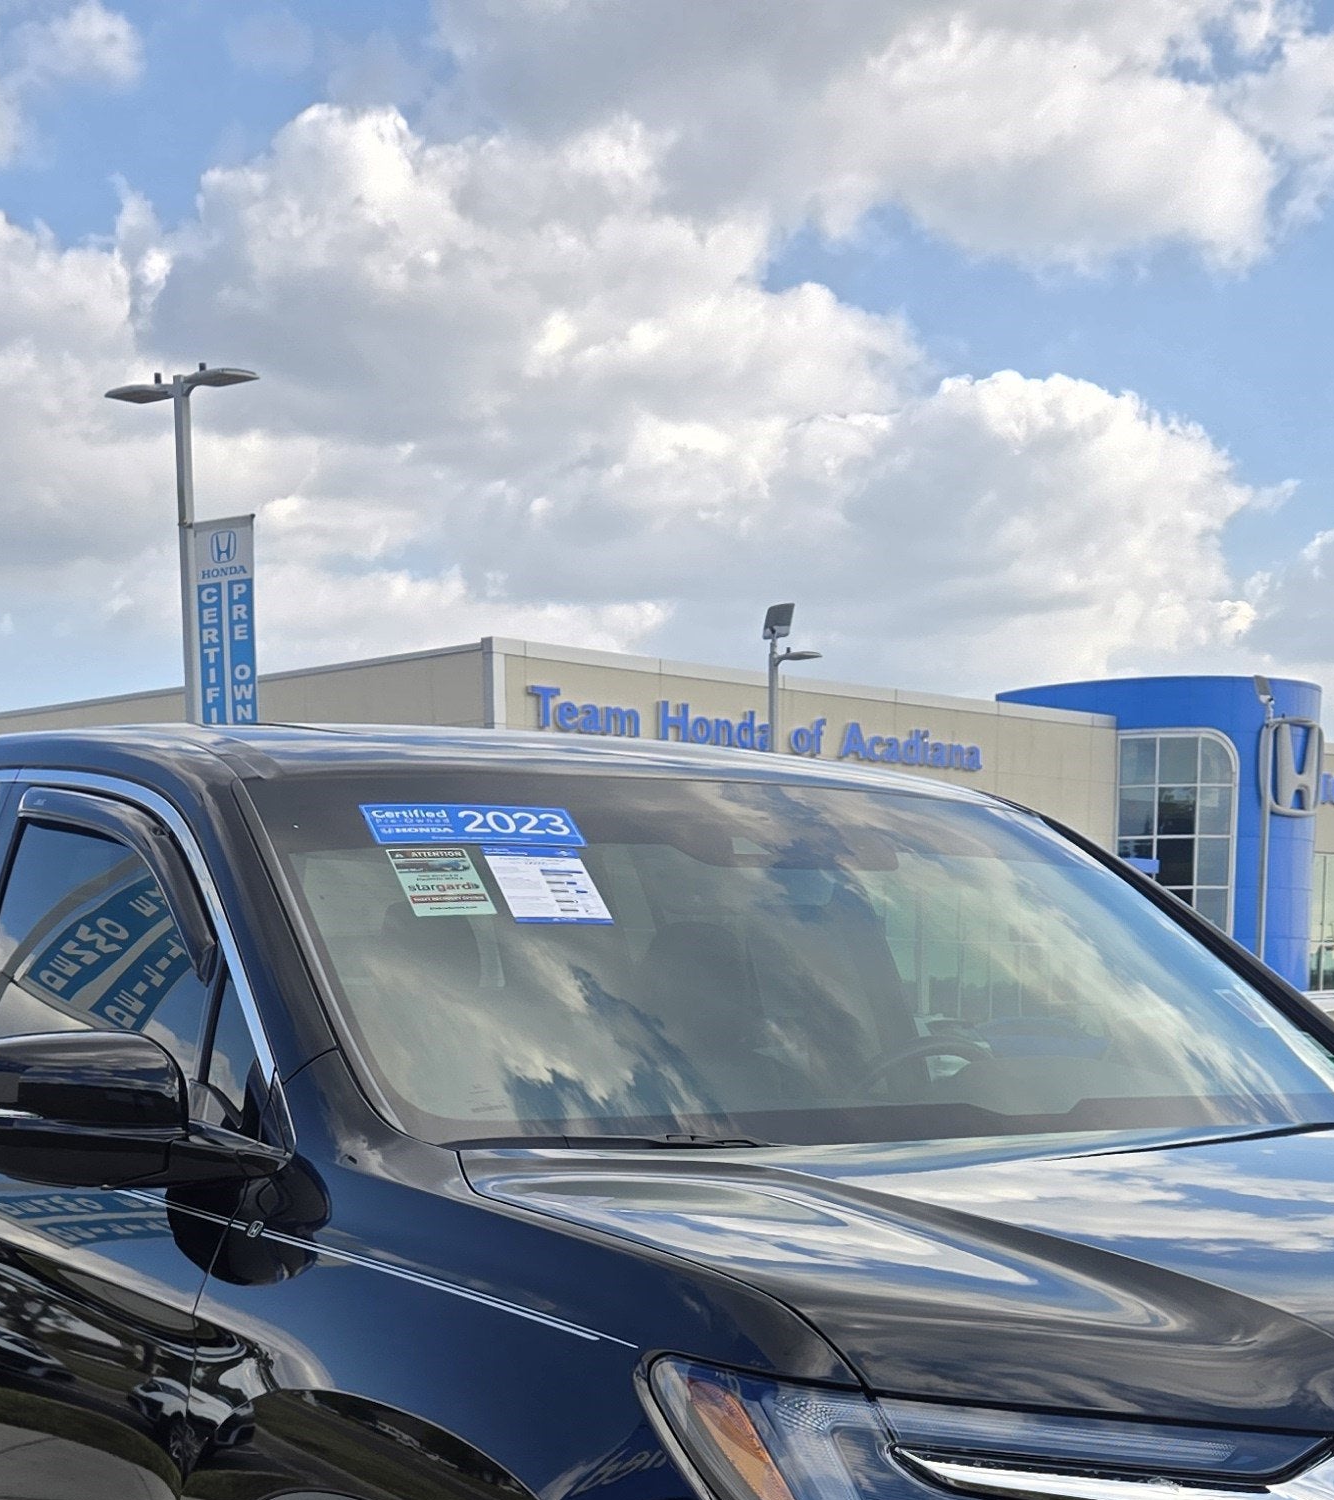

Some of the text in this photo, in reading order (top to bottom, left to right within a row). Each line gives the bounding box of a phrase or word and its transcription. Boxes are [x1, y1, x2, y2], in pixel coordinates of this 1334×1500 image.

[201, 565, 247, 579] HONDA
[201, 587, 220, 724] CERTIFI
[233, 664, 253, 722] OWN
[527, 684, 982, 772] Team Honda of Acadiana
[371, 807, 447, 819] Certified
[457, 810, 571, 836] 2023
